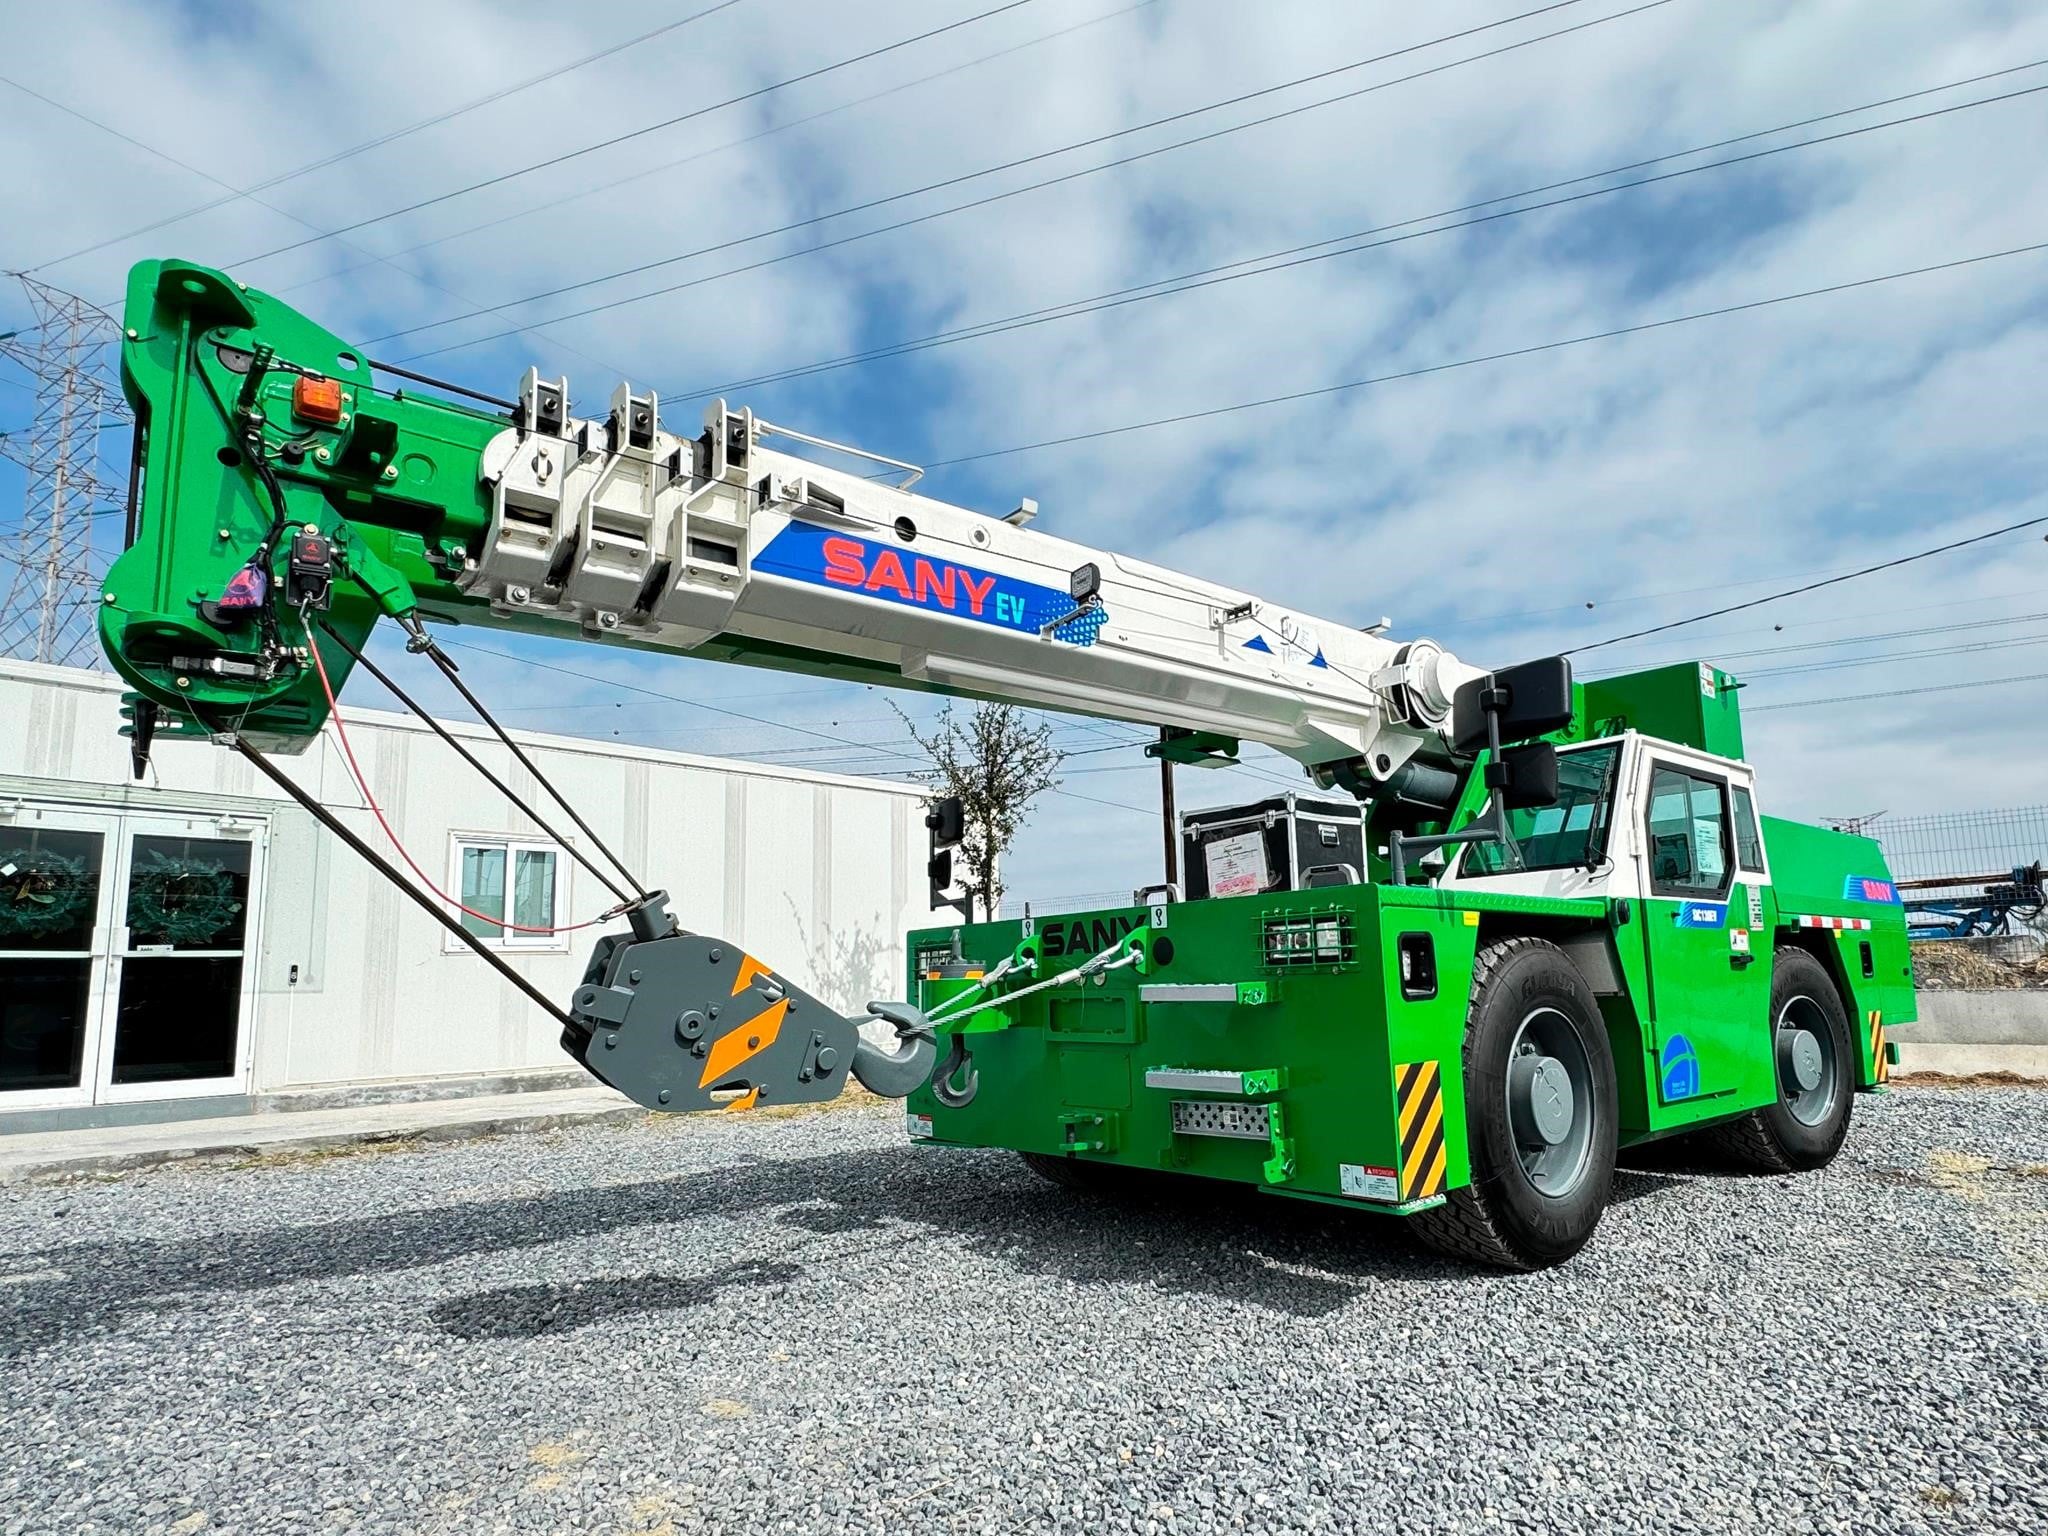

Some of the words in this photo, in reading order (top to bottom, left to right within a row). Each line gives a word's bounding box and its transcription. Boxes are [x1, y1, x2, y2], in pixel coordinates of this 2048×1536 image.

[823, 537, 996, 615] SANY
[996, 591, 1026, 625] EV
[1862, 880, 1892, 902] SANY
